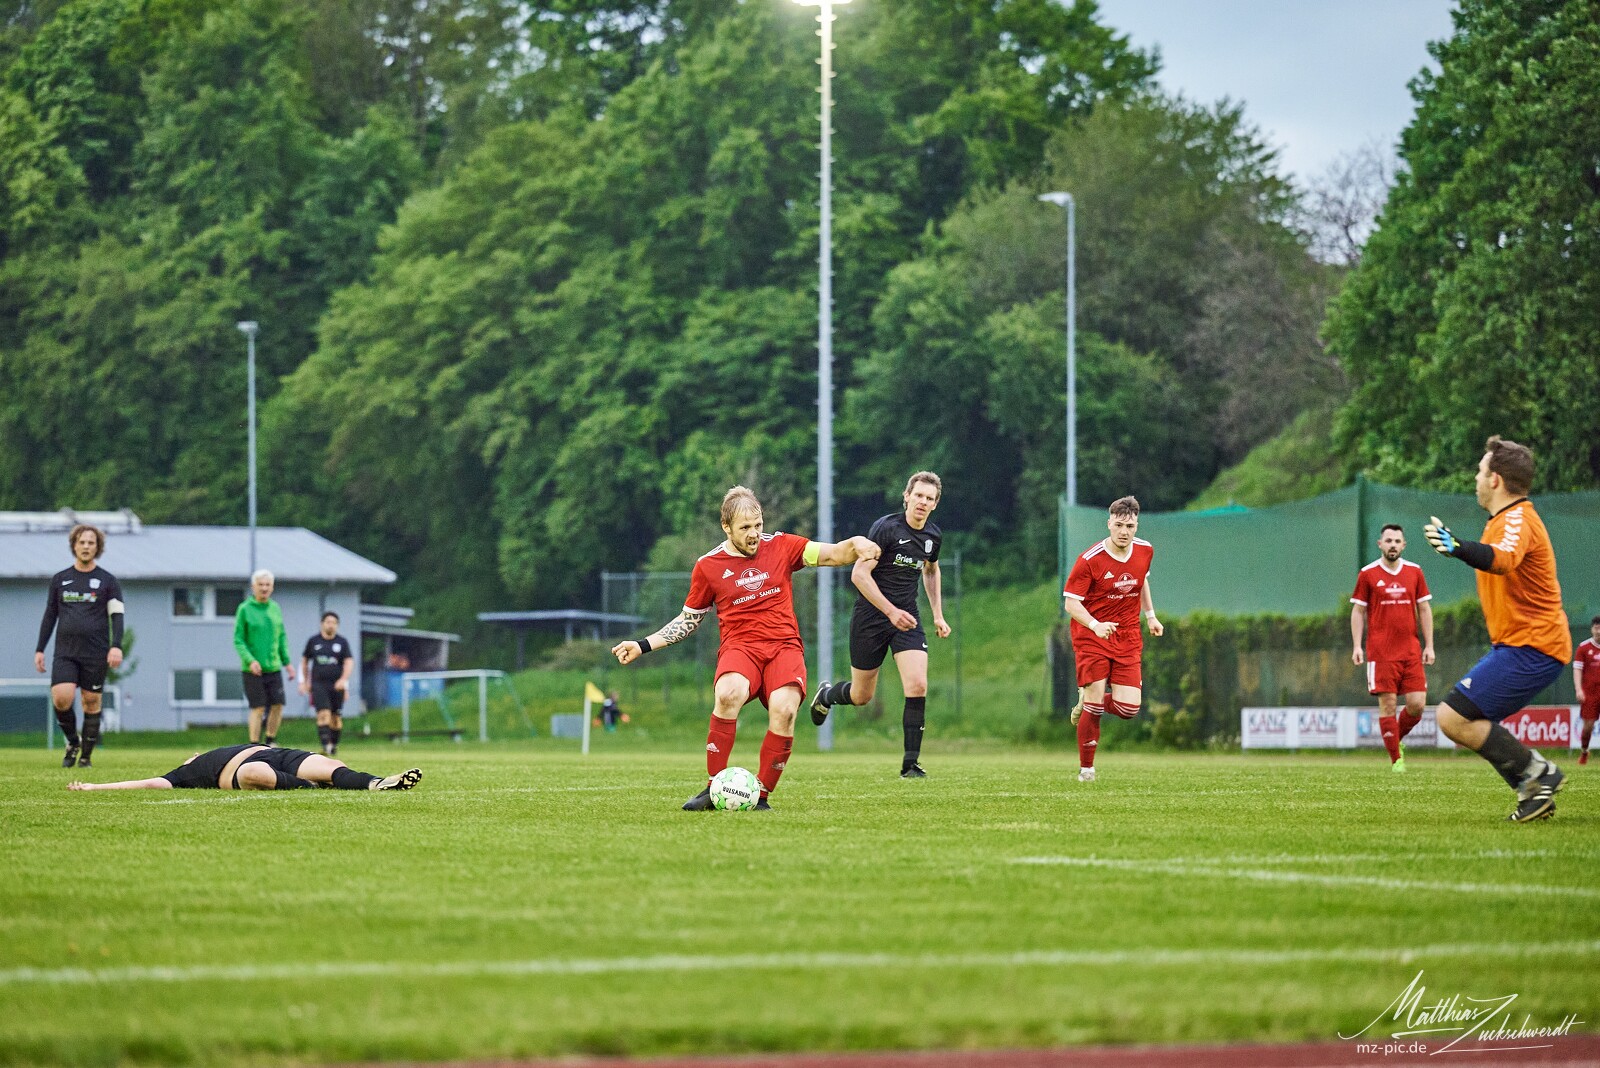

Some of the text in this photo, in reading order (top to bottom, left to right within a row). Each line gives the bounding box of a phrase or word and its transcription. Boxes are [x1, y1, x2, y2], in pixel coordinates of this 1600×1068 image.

[895, 553, 913, 564] Gries
[732, 594, 756, 606] HEIZUNG
[1250, 711, 1287, 726] KANZ
[1300, 711, 1338, 726] KANZ
[722, 786, 751, 799] DERBYSTAR
